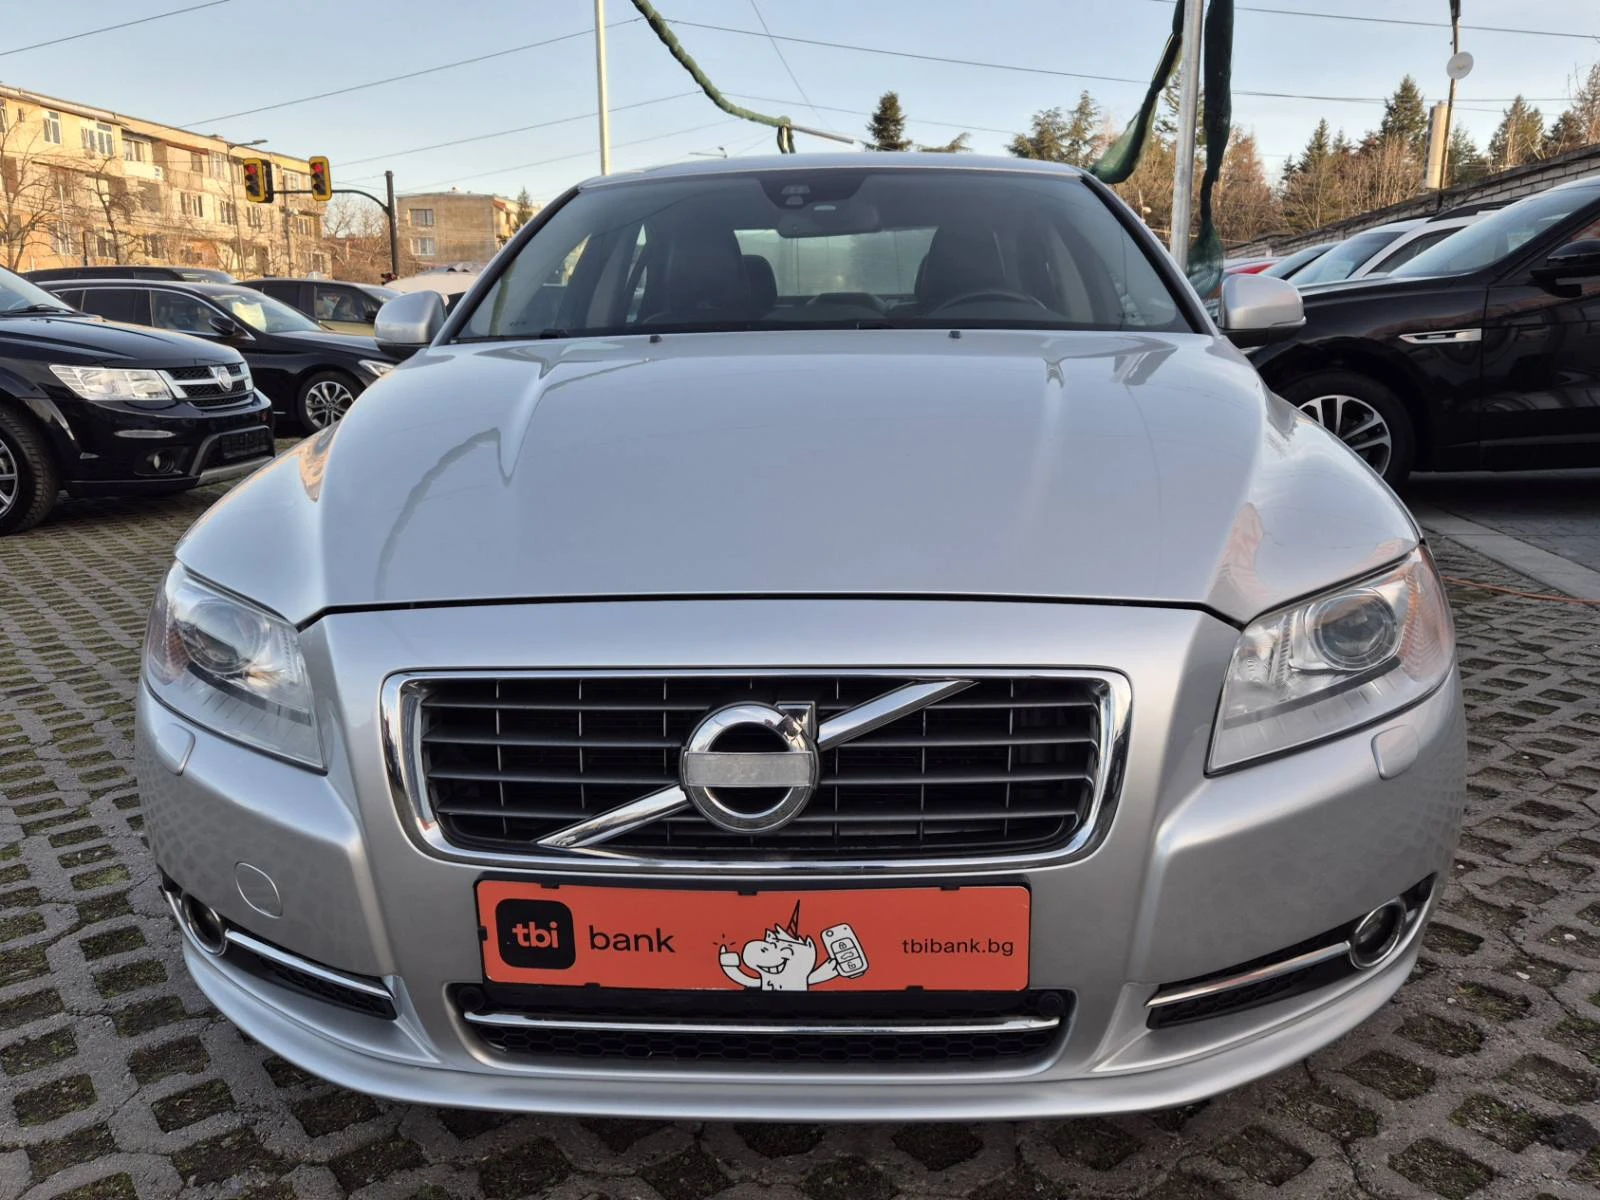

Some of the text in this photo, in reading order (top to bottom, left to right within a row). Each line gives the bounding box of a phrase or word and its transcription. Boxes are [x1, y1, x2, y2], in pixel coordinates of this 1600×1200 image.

[512, 921, 675, 953] tbi bank
[902, 938, 1014, 957] tbibank.bg
